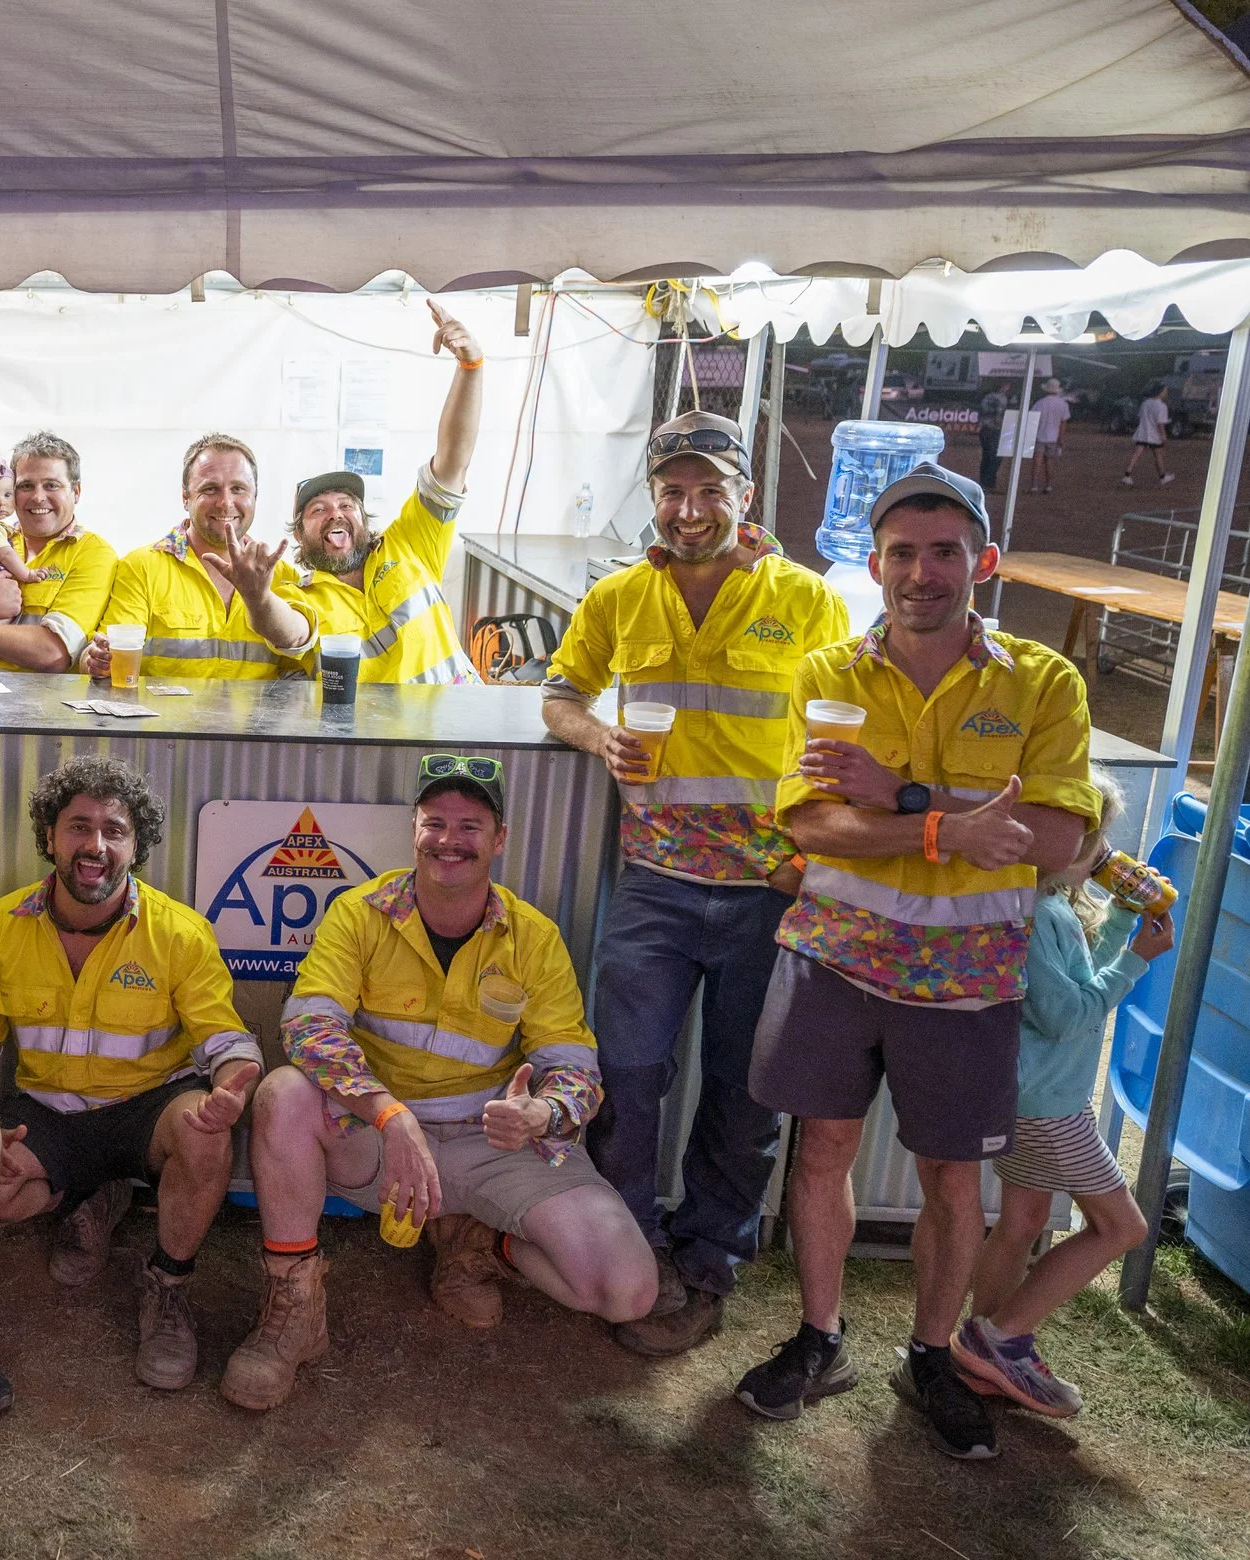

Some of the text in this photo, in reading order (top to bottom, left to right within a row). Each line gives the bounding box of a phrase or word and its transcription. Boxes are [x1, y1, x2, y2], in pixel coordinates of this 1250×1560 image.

[905, 406, 979, 423] Adelaide
[743, 621, 797, 647] Apex
[960, 716, 1024, 738] Apex
[287, 836, 323, 848] APEX
[267, 867, 340, 878] AUSTRALIA
[109, 969, 157, 991] Apex
